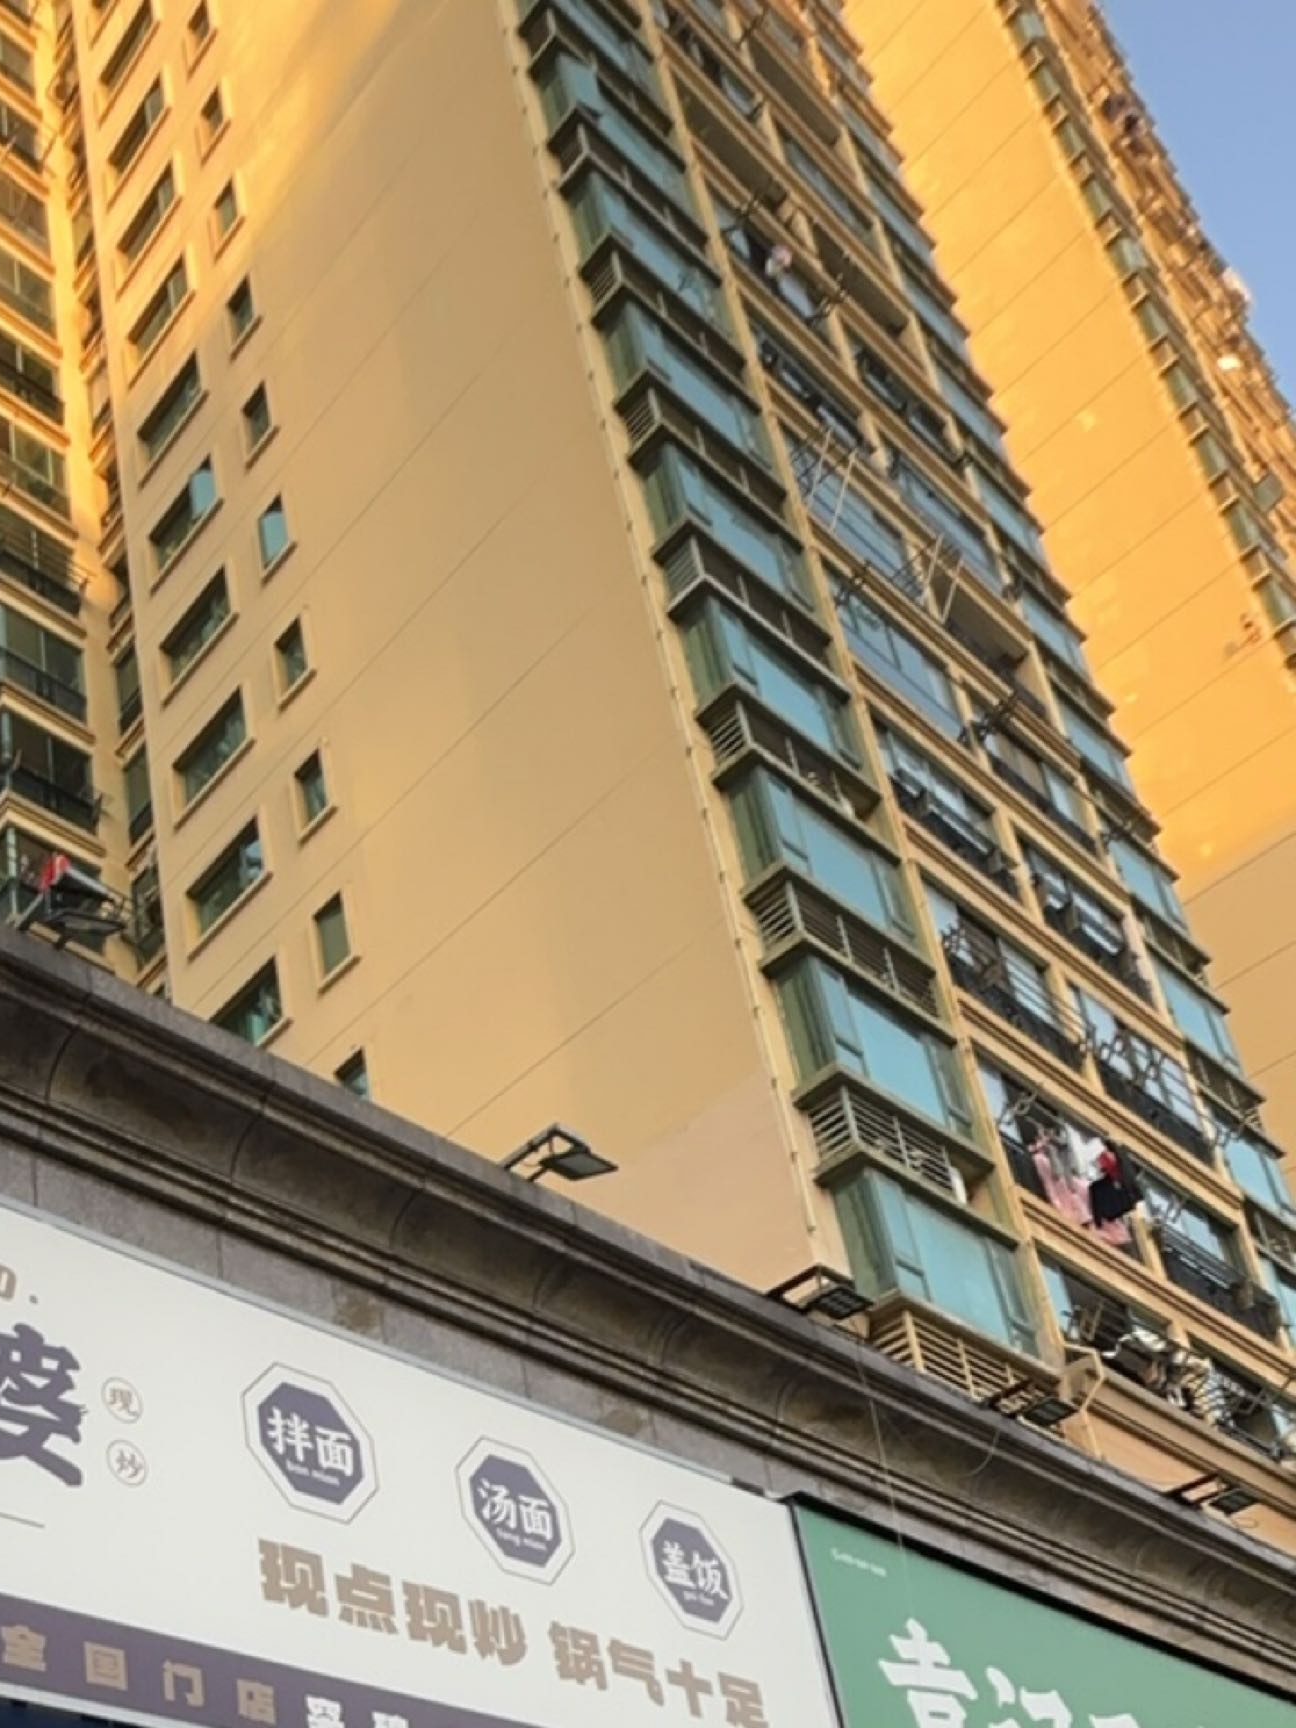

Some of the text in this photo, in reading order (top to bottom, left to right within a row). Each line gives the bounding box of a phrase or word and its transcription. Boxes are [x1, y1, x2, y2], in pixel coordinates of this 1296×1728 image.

[267, 1407, 355, 1477] 拌面
[477, 1477, 553, 1541] 汤面
[257, 1537, 528, 1668] 现点现炒
[662, 1540, 729, 1600] 盖饭
